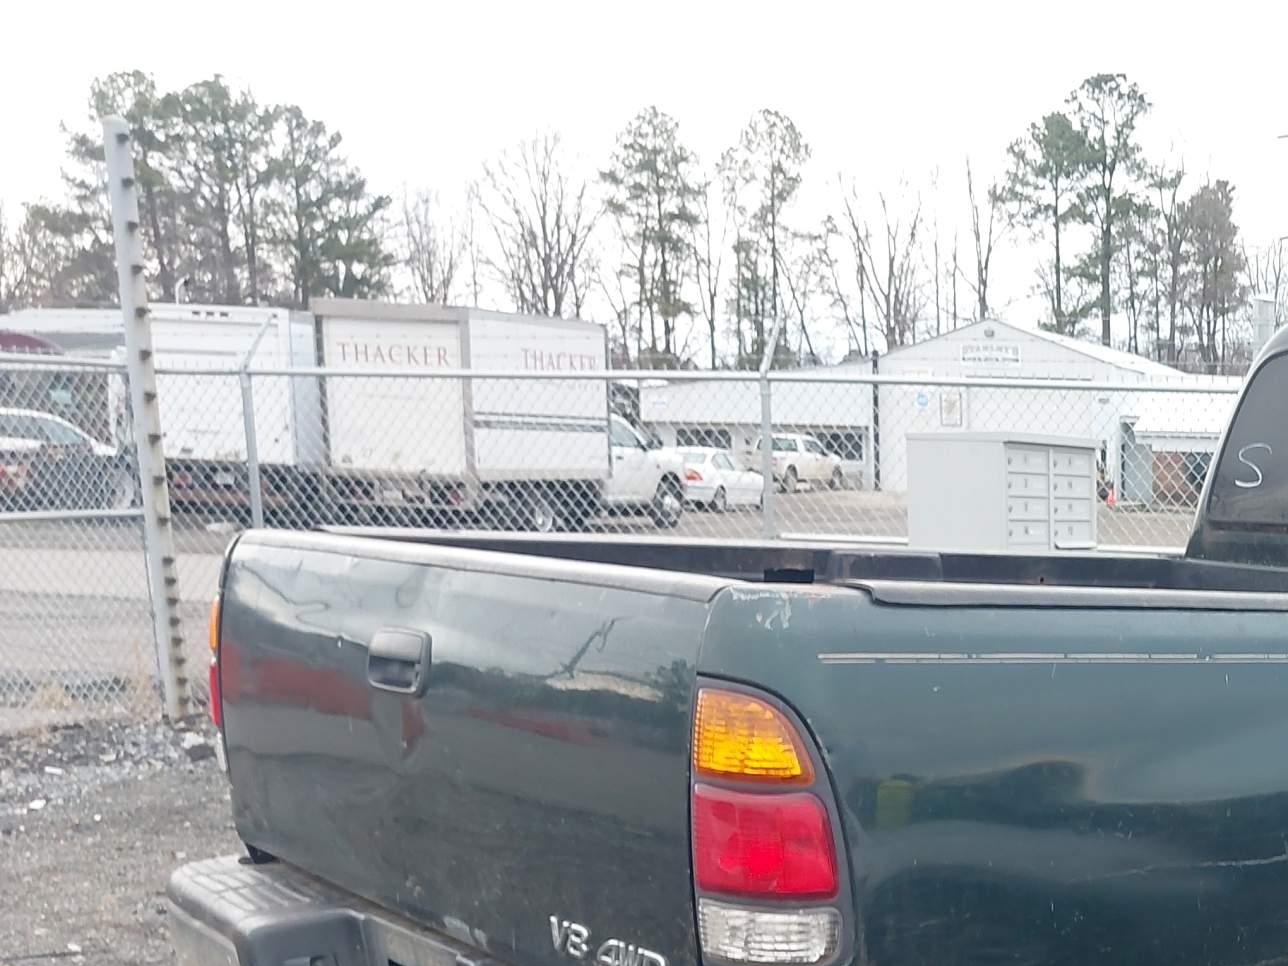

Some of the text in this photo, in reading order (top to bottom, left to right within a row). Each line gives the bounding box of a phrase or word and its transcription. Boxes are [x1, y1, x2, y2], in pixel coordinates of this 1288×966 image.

[337, 341, 450, 367] THACKER
[521, 348, 599, 371] THACKER
[1235, 443, 1272, 488] S
[549, 915, 590, 959] V8
